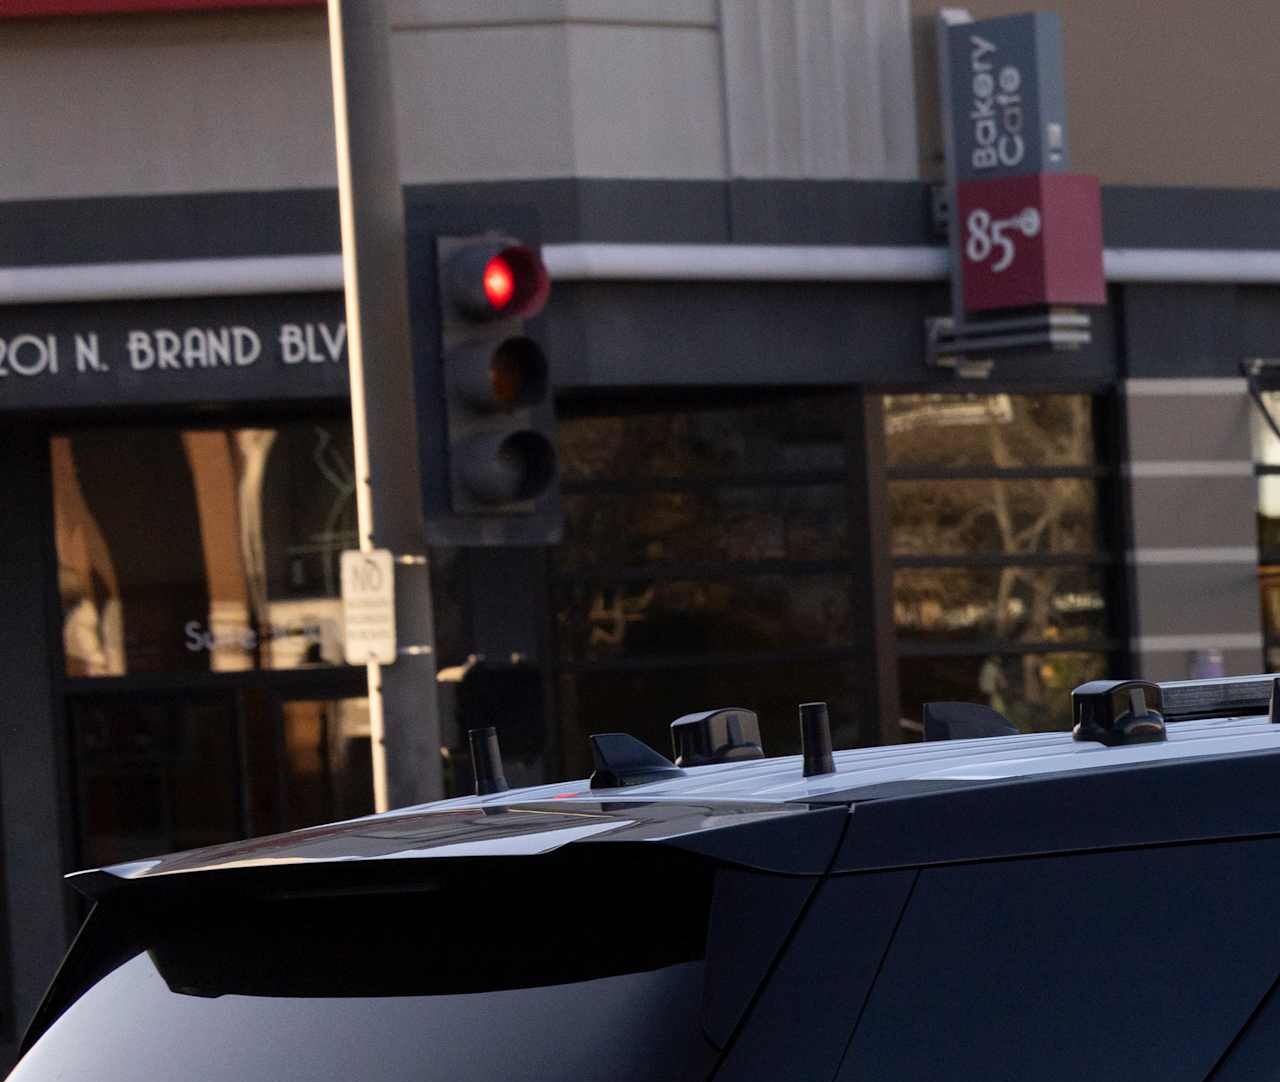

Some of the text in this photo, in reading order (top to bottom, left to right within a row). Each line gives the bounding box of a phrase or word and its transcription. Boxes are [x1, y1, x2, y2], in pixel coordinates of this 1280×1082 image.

[970, 35, 997, 168] Bakery
[74, 332, 109, 373] N.
[127, 326, 261, 371] BRAND
[279, 322, 348, 364] BLV
